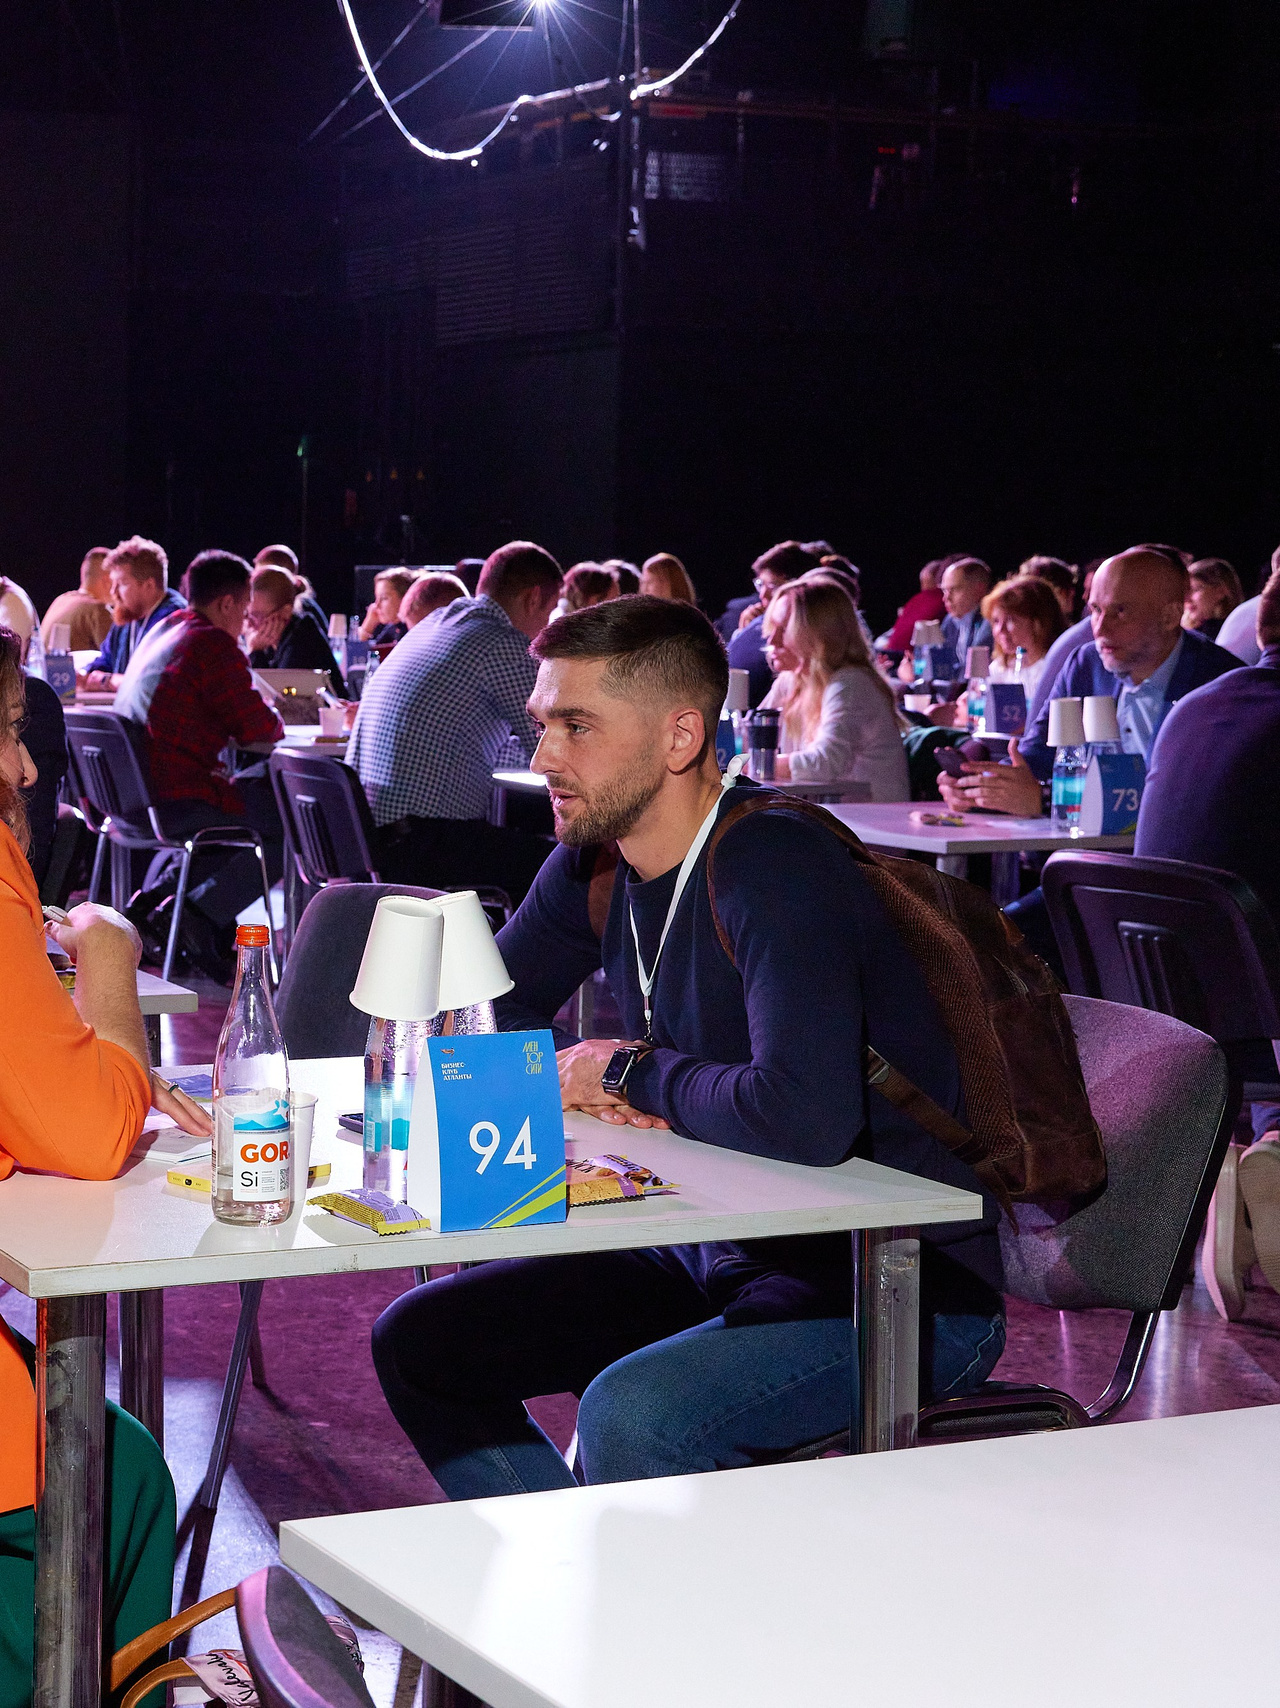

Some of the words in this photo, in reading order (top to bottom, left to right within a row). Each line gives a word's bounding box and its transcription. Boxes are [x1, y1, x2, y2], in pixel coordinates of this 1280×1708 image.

[1112, 788, 1139, 812] 73
[469, 1115, 537, 1175] 94
[240, 1171, 259, 1187] Si
